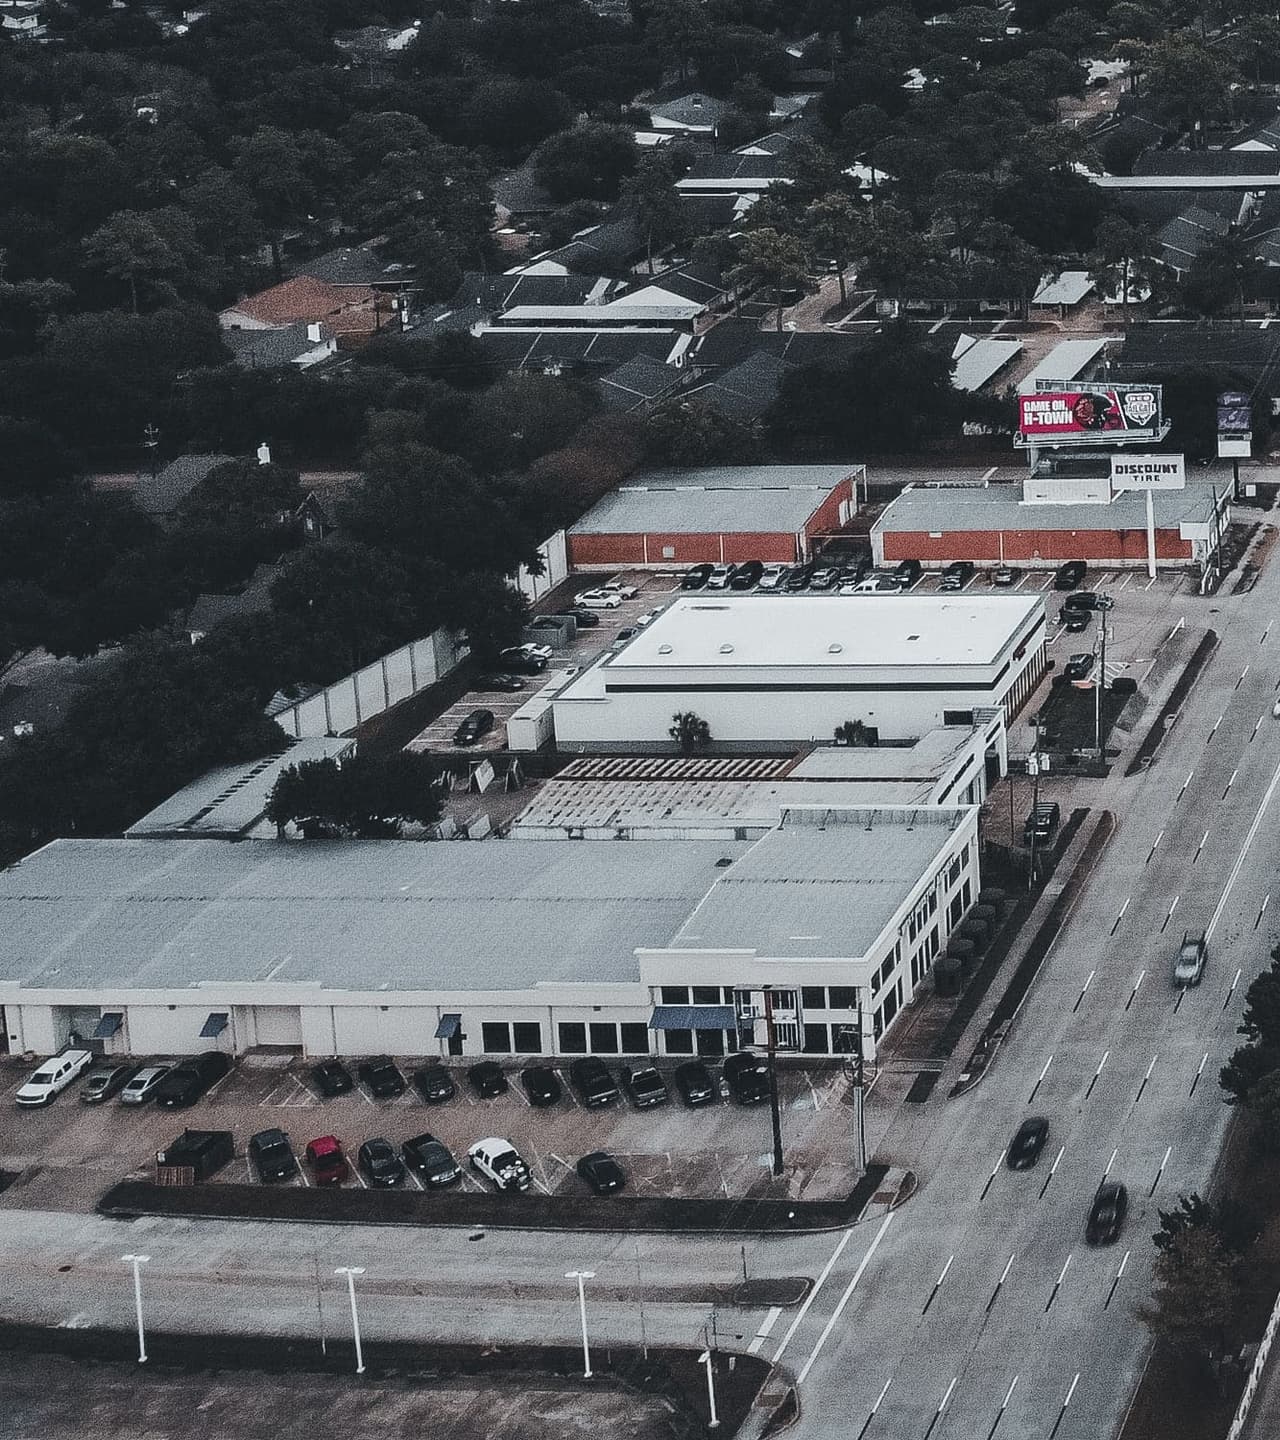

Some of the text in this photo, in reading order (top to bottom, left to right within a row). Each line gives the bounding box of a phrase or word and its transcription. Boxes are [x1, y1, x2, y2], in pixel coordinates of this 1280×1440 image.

[1024, 401, 1050, 411] GAME
[1024, 410, 1073, 425] H-TOWN
[1115, 464, 1178, 474] DISCOUNT
